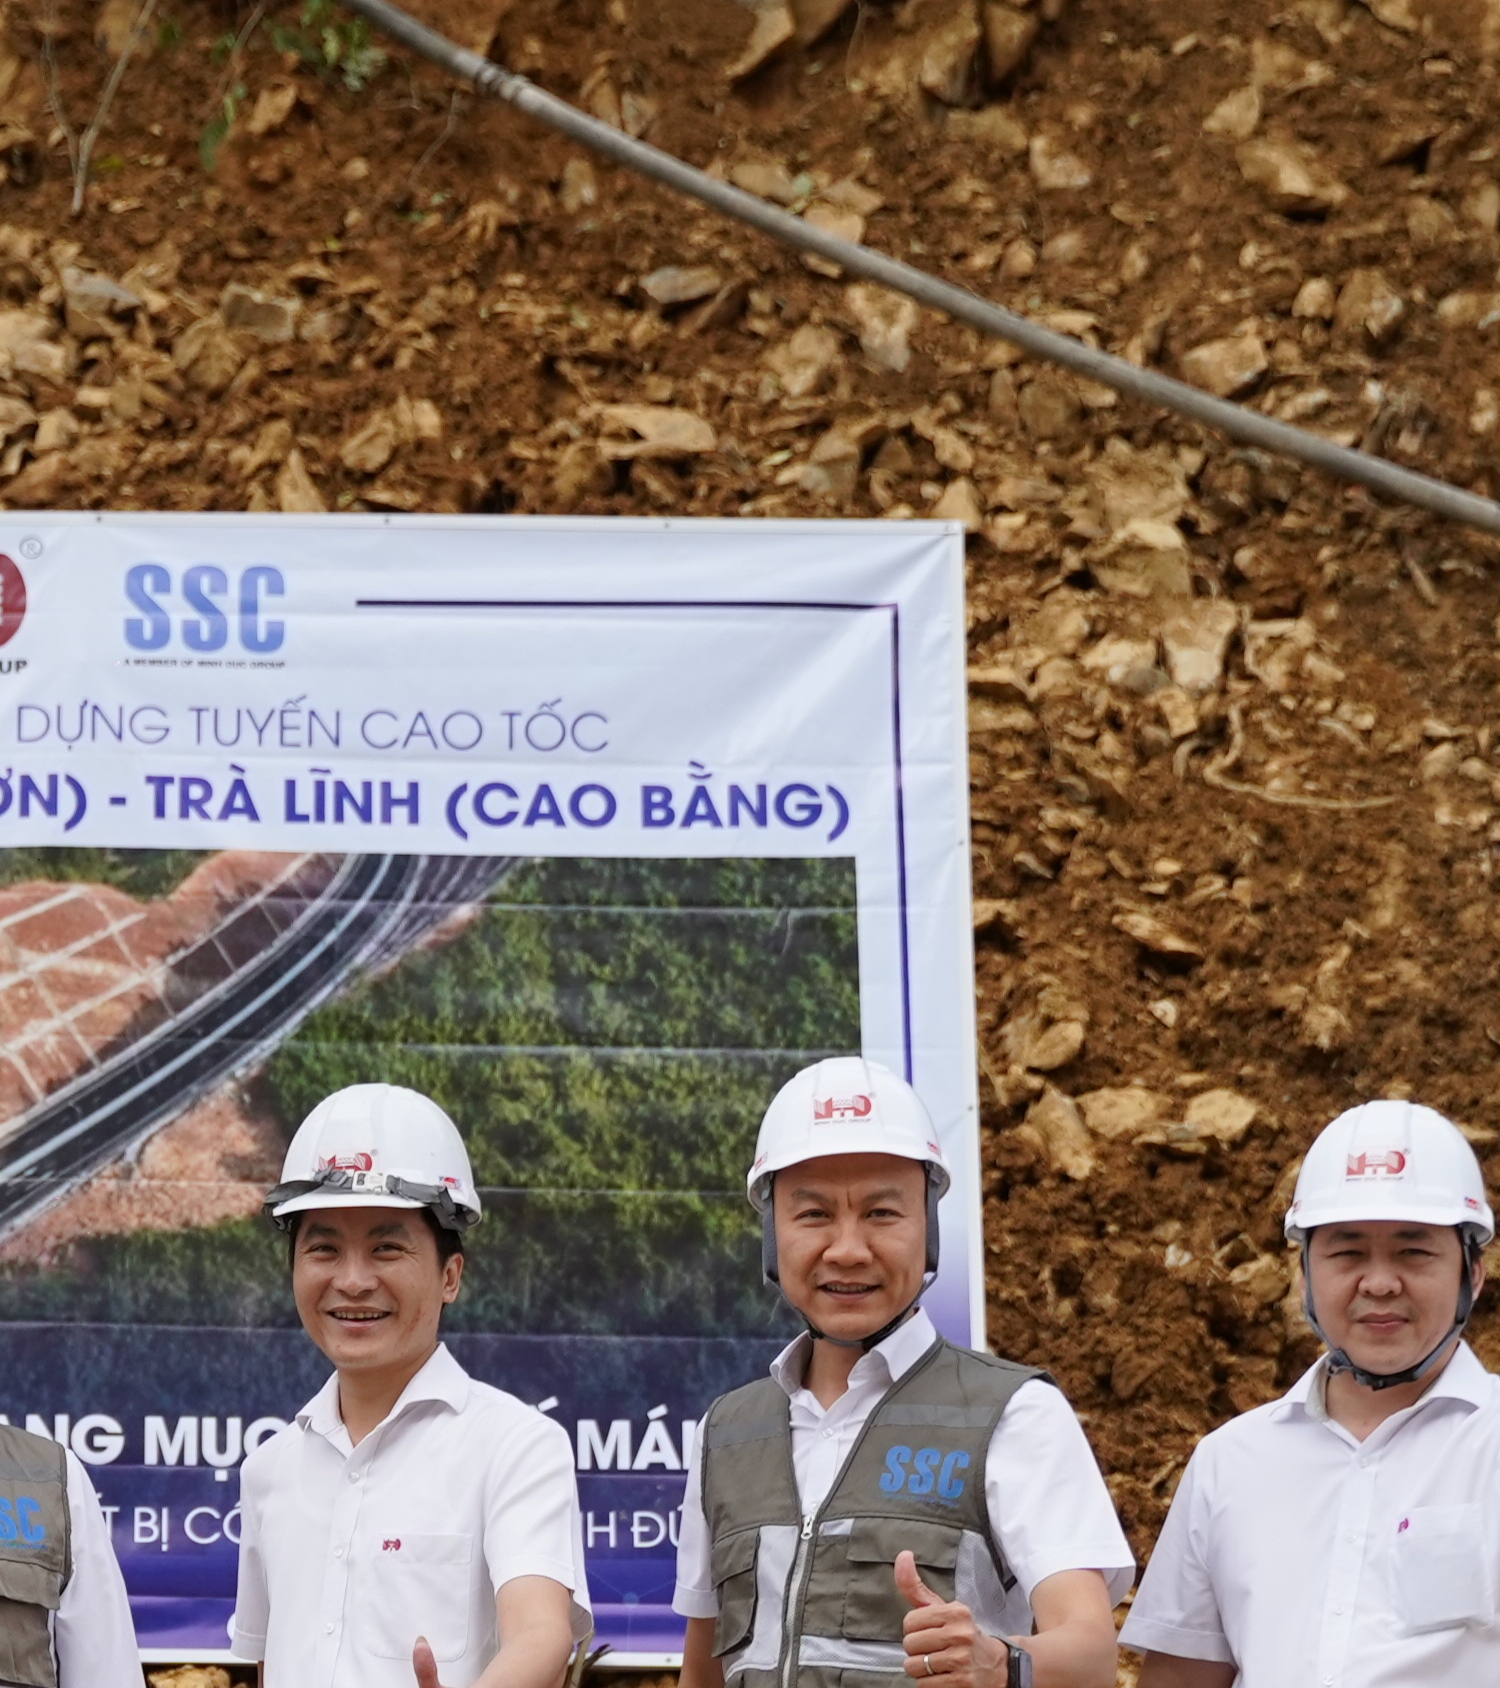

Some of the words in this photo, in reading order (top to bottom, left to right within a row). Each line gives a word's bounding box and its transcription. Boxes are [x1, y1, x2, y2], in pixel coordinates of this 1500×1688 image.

[122, 563, 286, 653] SSC
[16, 699, 171, 752] DỰNG
[188, 694, 341, 749] TUYẾN
[360, 709, 484, 752] CAO
[500, 698, 610, 753] TỐC
[108, 796, 128, 807] -
[145, 763, 262, 823] TRÀ
[283, 766, 421, 826] LĨNH
[445, 781, 618, 842] (CAO
[640, 760, 850, 843] BẰNG)
[879, 1445, 970, 1499] SSC
[133, 1506, 170, 1552] BỊ
